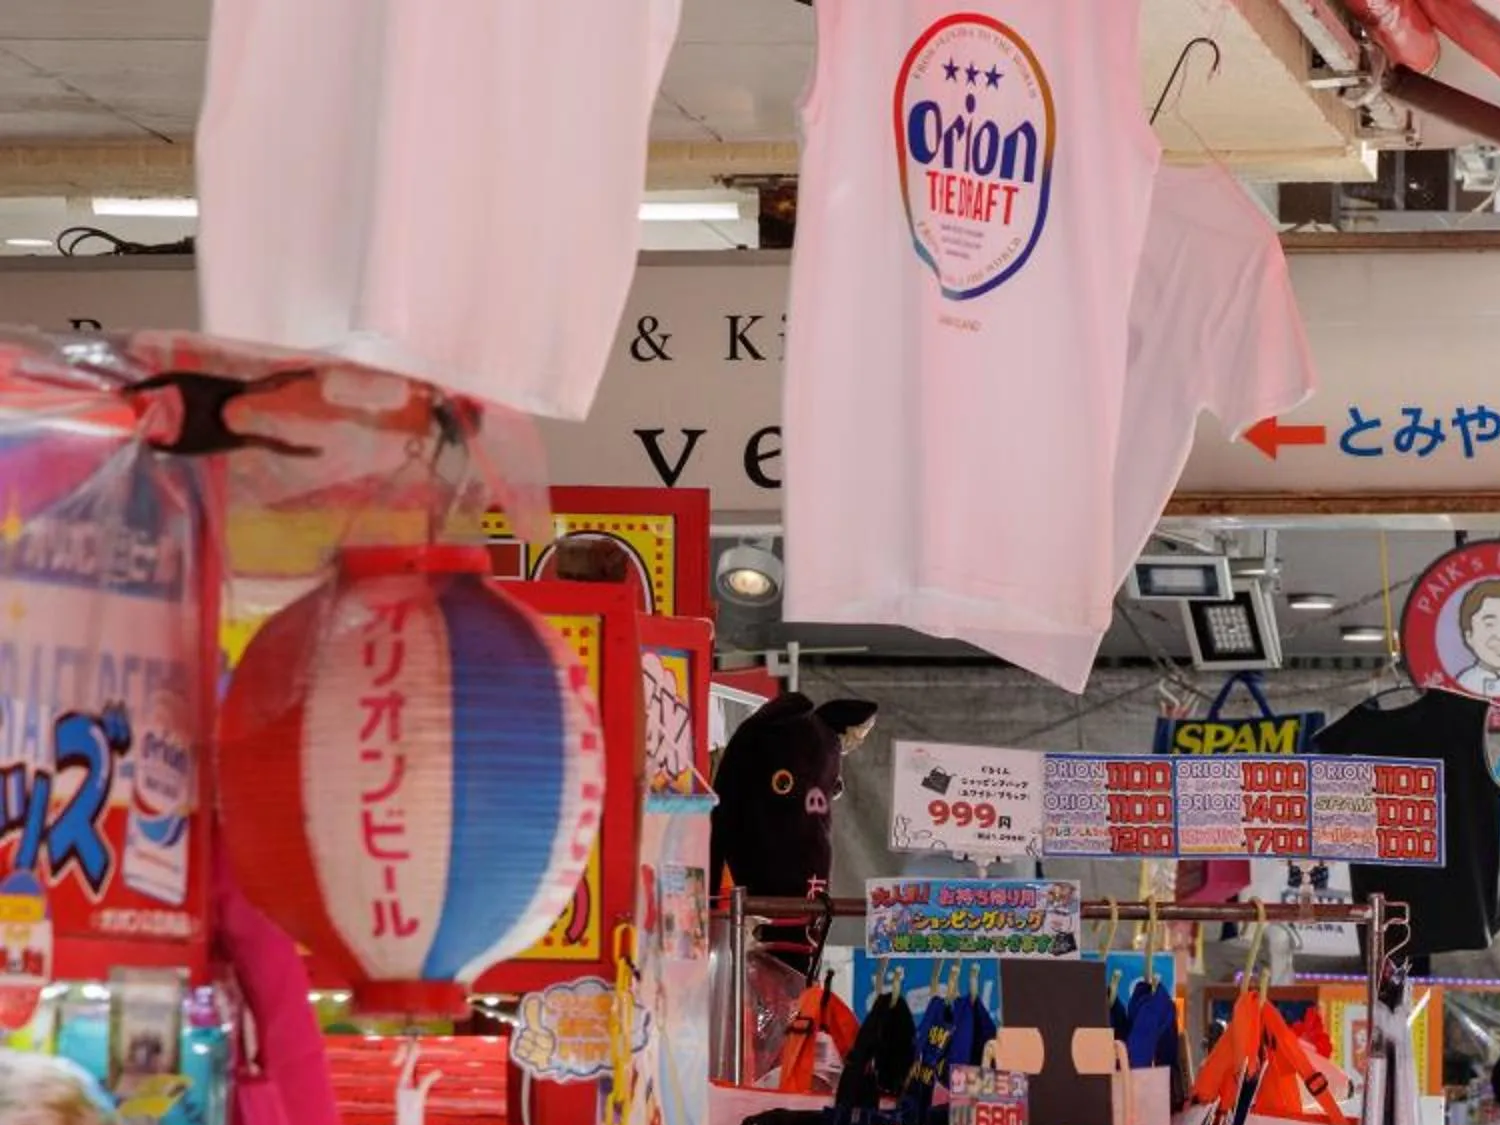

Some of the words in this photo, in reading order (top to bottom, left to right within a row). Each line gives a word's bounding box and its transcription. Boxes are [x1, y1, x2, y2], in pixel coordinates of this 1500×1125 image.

[908, 93, 1037, 183] Orion
[630, 316, 673, 362] &
[1417, 553, 1484, 615] PAIK's
[1173, 720, 1302, 755] SPAM
[359, 602, 420, 938] オリオンビール
[1044, 760, 1106, 779] ORION
[1179, 762, 1241, 779] ORION
[1311, 763, 1374, 781] ORION
[1043, 793, 1107, 811] ORION
[1180, 793, 1241, 811] ORION
[911, 909, 1046, 932] ショッピングバッグ
